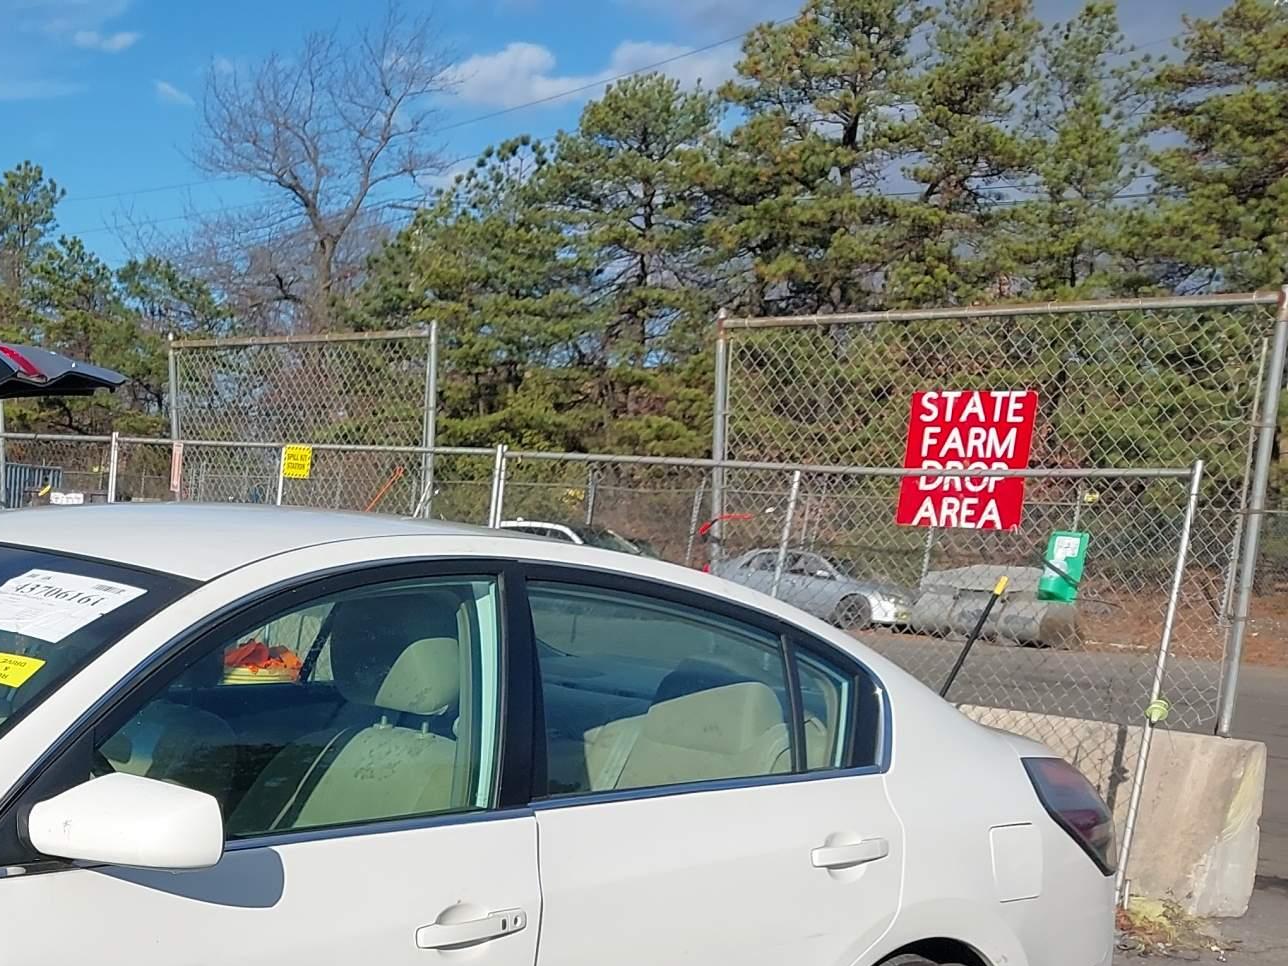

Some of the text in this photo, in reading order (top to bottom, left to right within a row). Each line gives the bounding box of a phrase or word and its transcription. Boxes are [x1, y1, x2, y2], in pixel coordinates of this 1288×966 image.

[919, 391, 1027, 423] STATE
[920, 426, 1018, 459] FARM
[918, 460, 1009, 493] DROP
[912, 496, 1003, 529] AREA
[15, 583, 105, 606] 43706161
[0, 658, 27, 668] DRIVE
